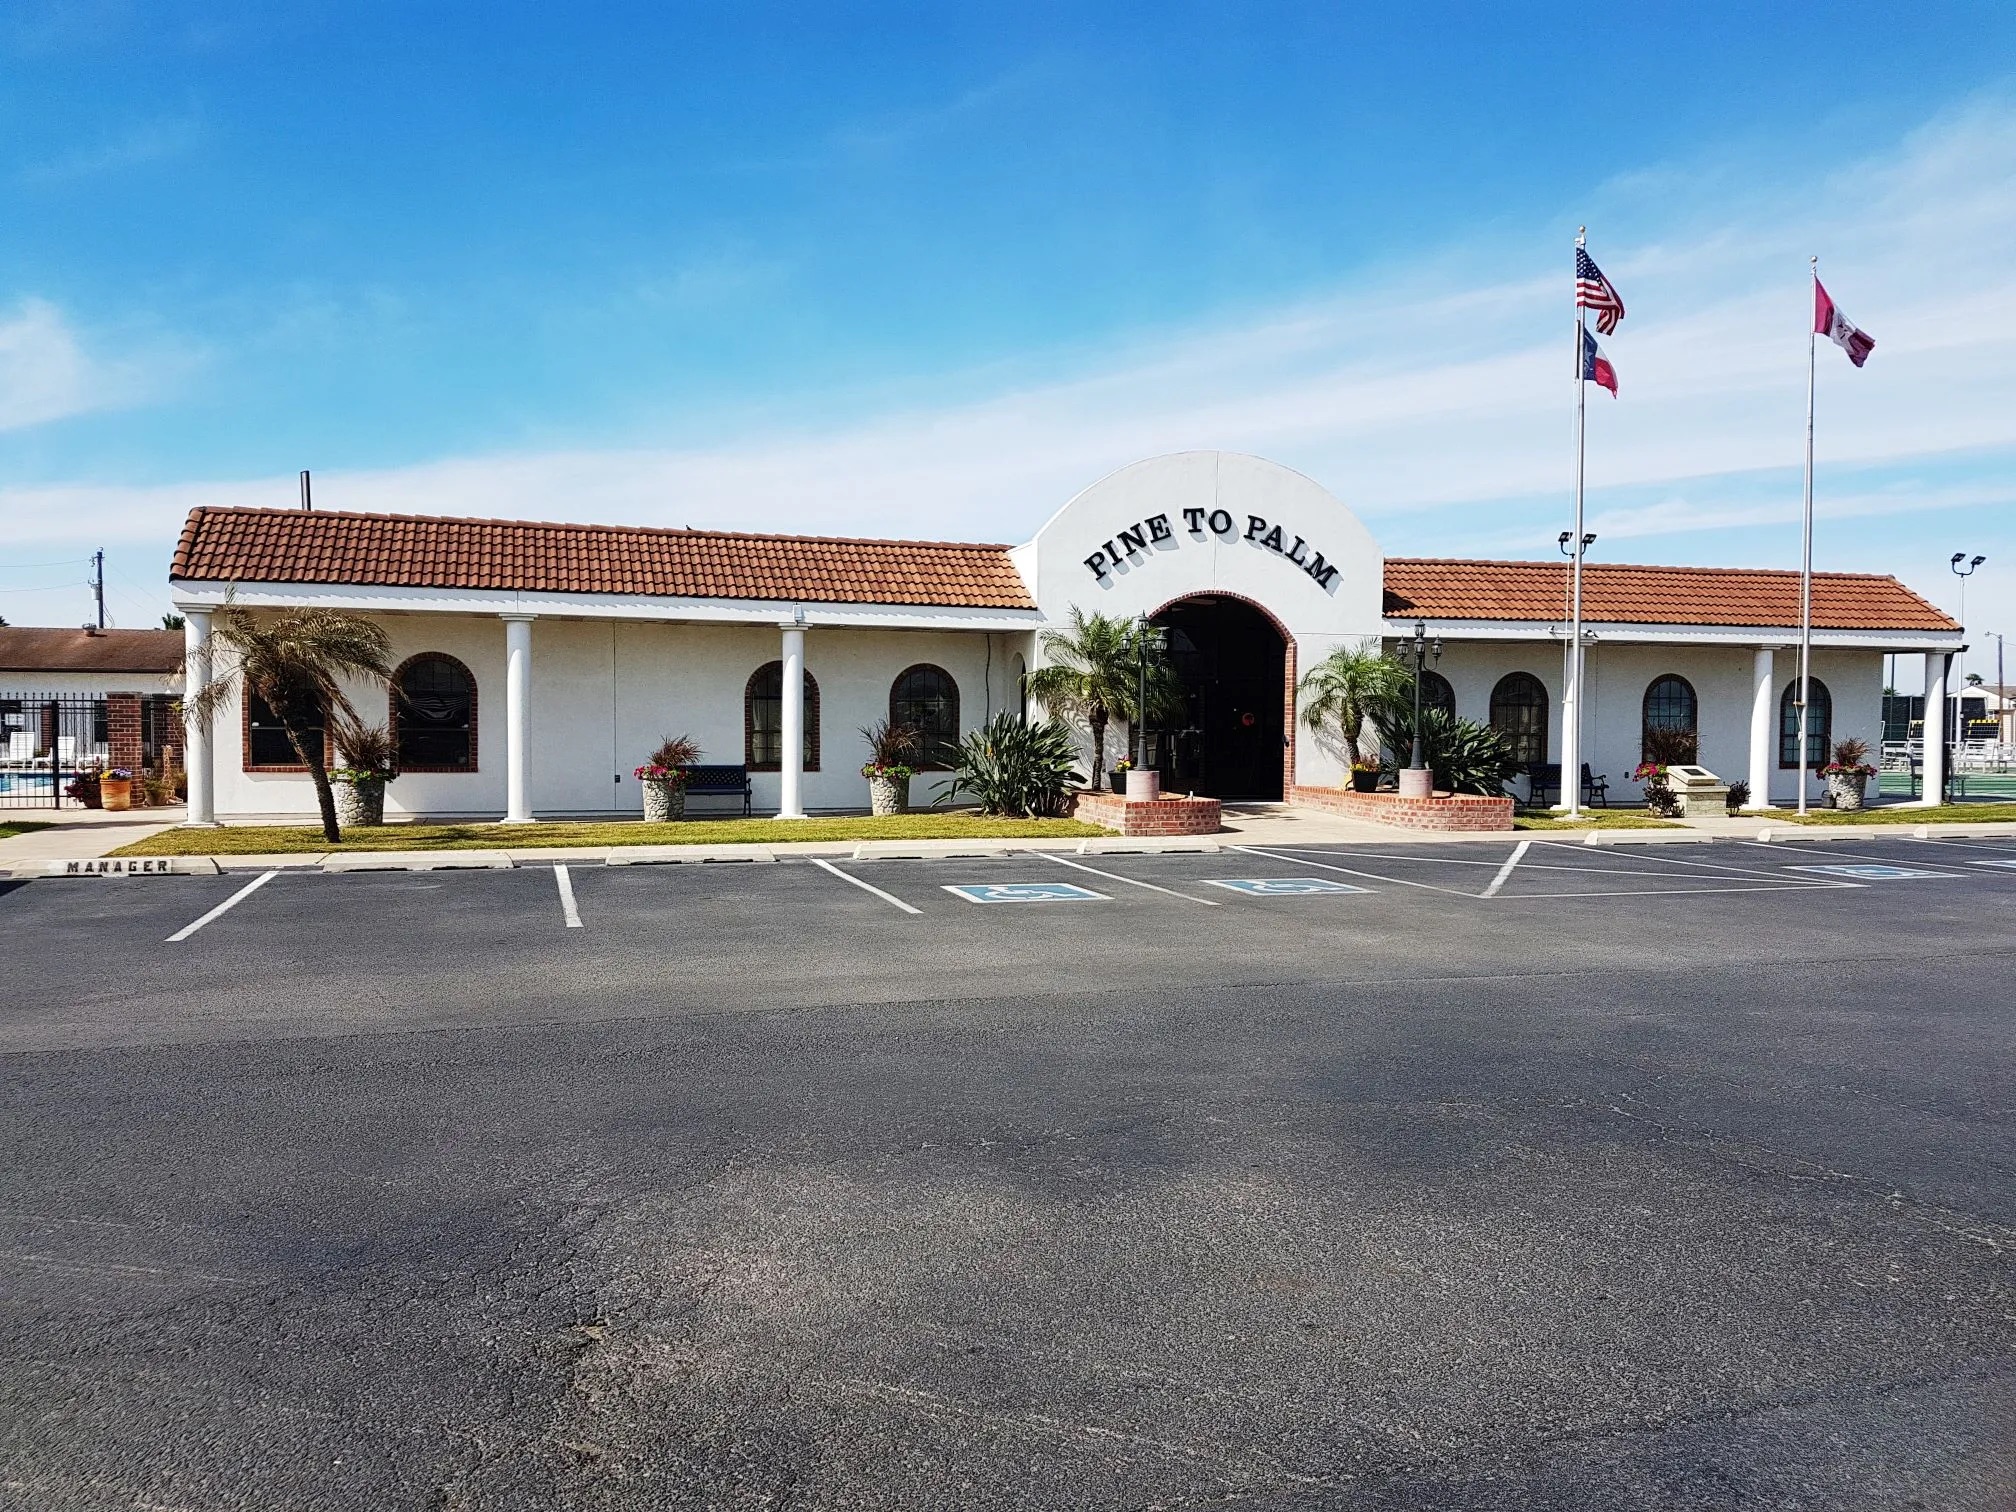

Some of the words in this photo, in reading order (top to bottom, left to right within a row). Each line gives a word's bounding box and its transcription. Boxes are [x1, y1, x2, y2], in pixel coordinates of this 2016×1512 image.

[1083, 513, 1172, 581] PINE
[1183, 507, 1232, 535] TO
[1243, 514, 1339, 589] PALM
[66, 860, 168, 873] MANAGER
